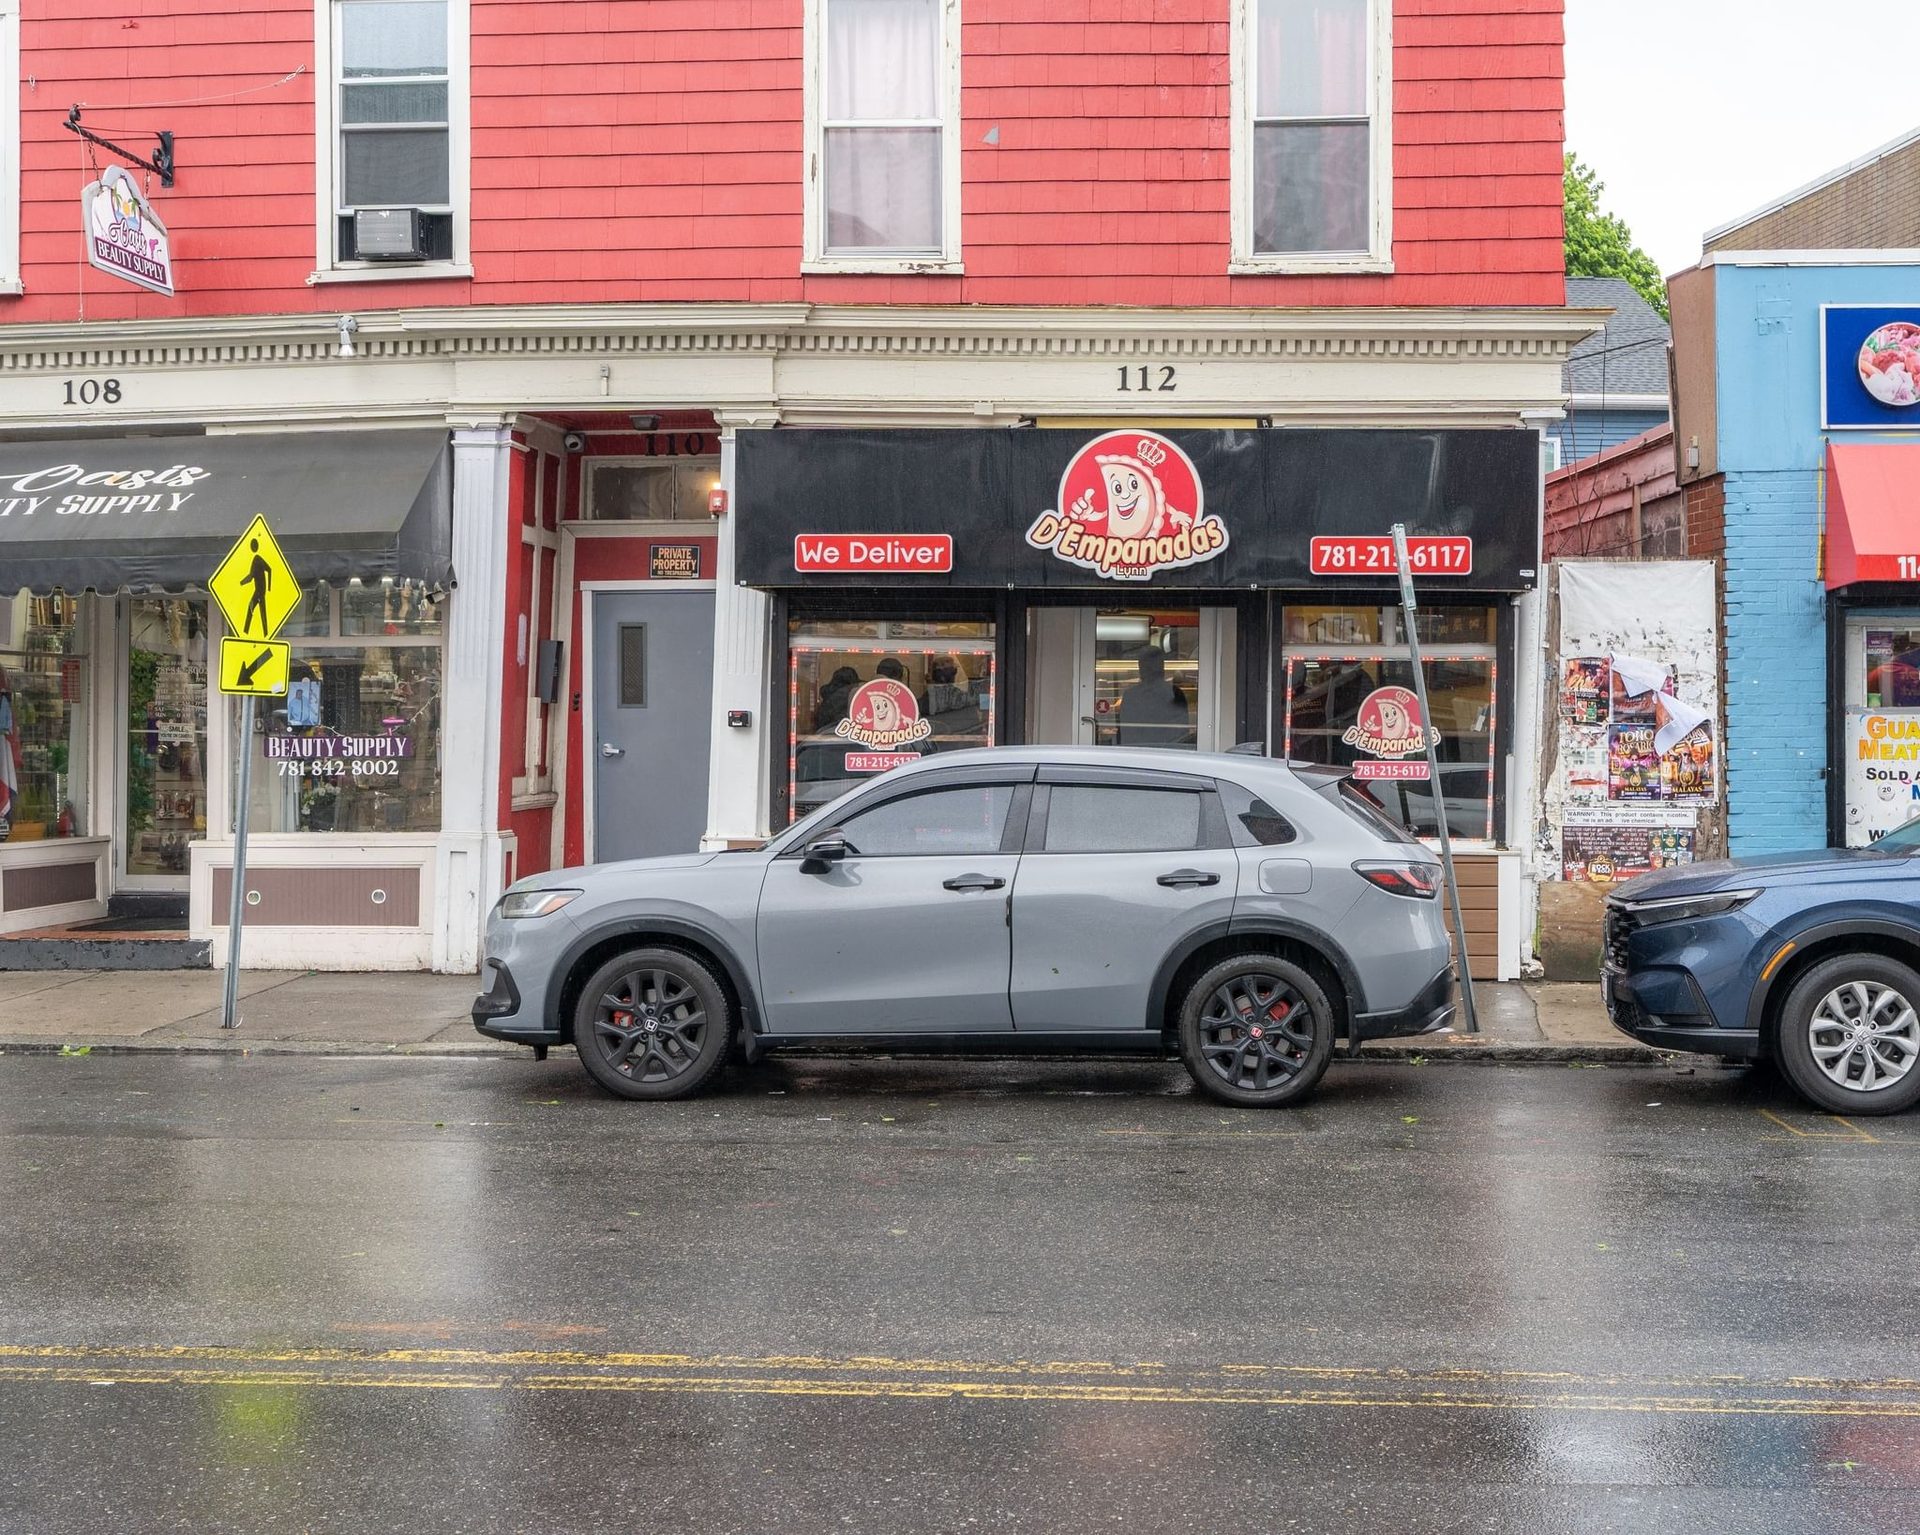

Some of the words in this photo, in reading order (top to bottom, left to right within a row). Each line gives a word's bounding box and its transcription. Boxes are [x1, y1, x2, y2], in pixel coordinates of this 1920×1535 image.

[98, 240, 134, 268] BEAUTY
[133, 255, 164, 281] SUPPLY
[1117, 366, 1177, 391] 112
[63, 379, 122, 405] 108
[645, 433, 704, 456] 110
[0, 464, 211, 492] Oasis
[56, 493, 195, 515] SUPPLY
[658, 548, 692, 559] PRIVATE
[801, 541, 840, 564] We
[850, 541, 944, 564] Deliver
[1030, 514, 1224, 572] D'Empanadas
[653, 559, 697, 571] PROPERTY
[1116, 564, 1148, 577] Lynn
[1897, 556, 1920, 579] 11
[838, 720, 928, 747] D'Empanadas
[268, 737, 336, 757] BEAUTY
[342, 736, 407, 757] SUPPLY
[277, 761, 305, 776] 781
[312, 761, 345, 776] 842
[351, 760, 399, 776] 8002
[1357, 765, 1427, 776] 781-215-6117
[1866, 768, 1909, 780] SOLD
